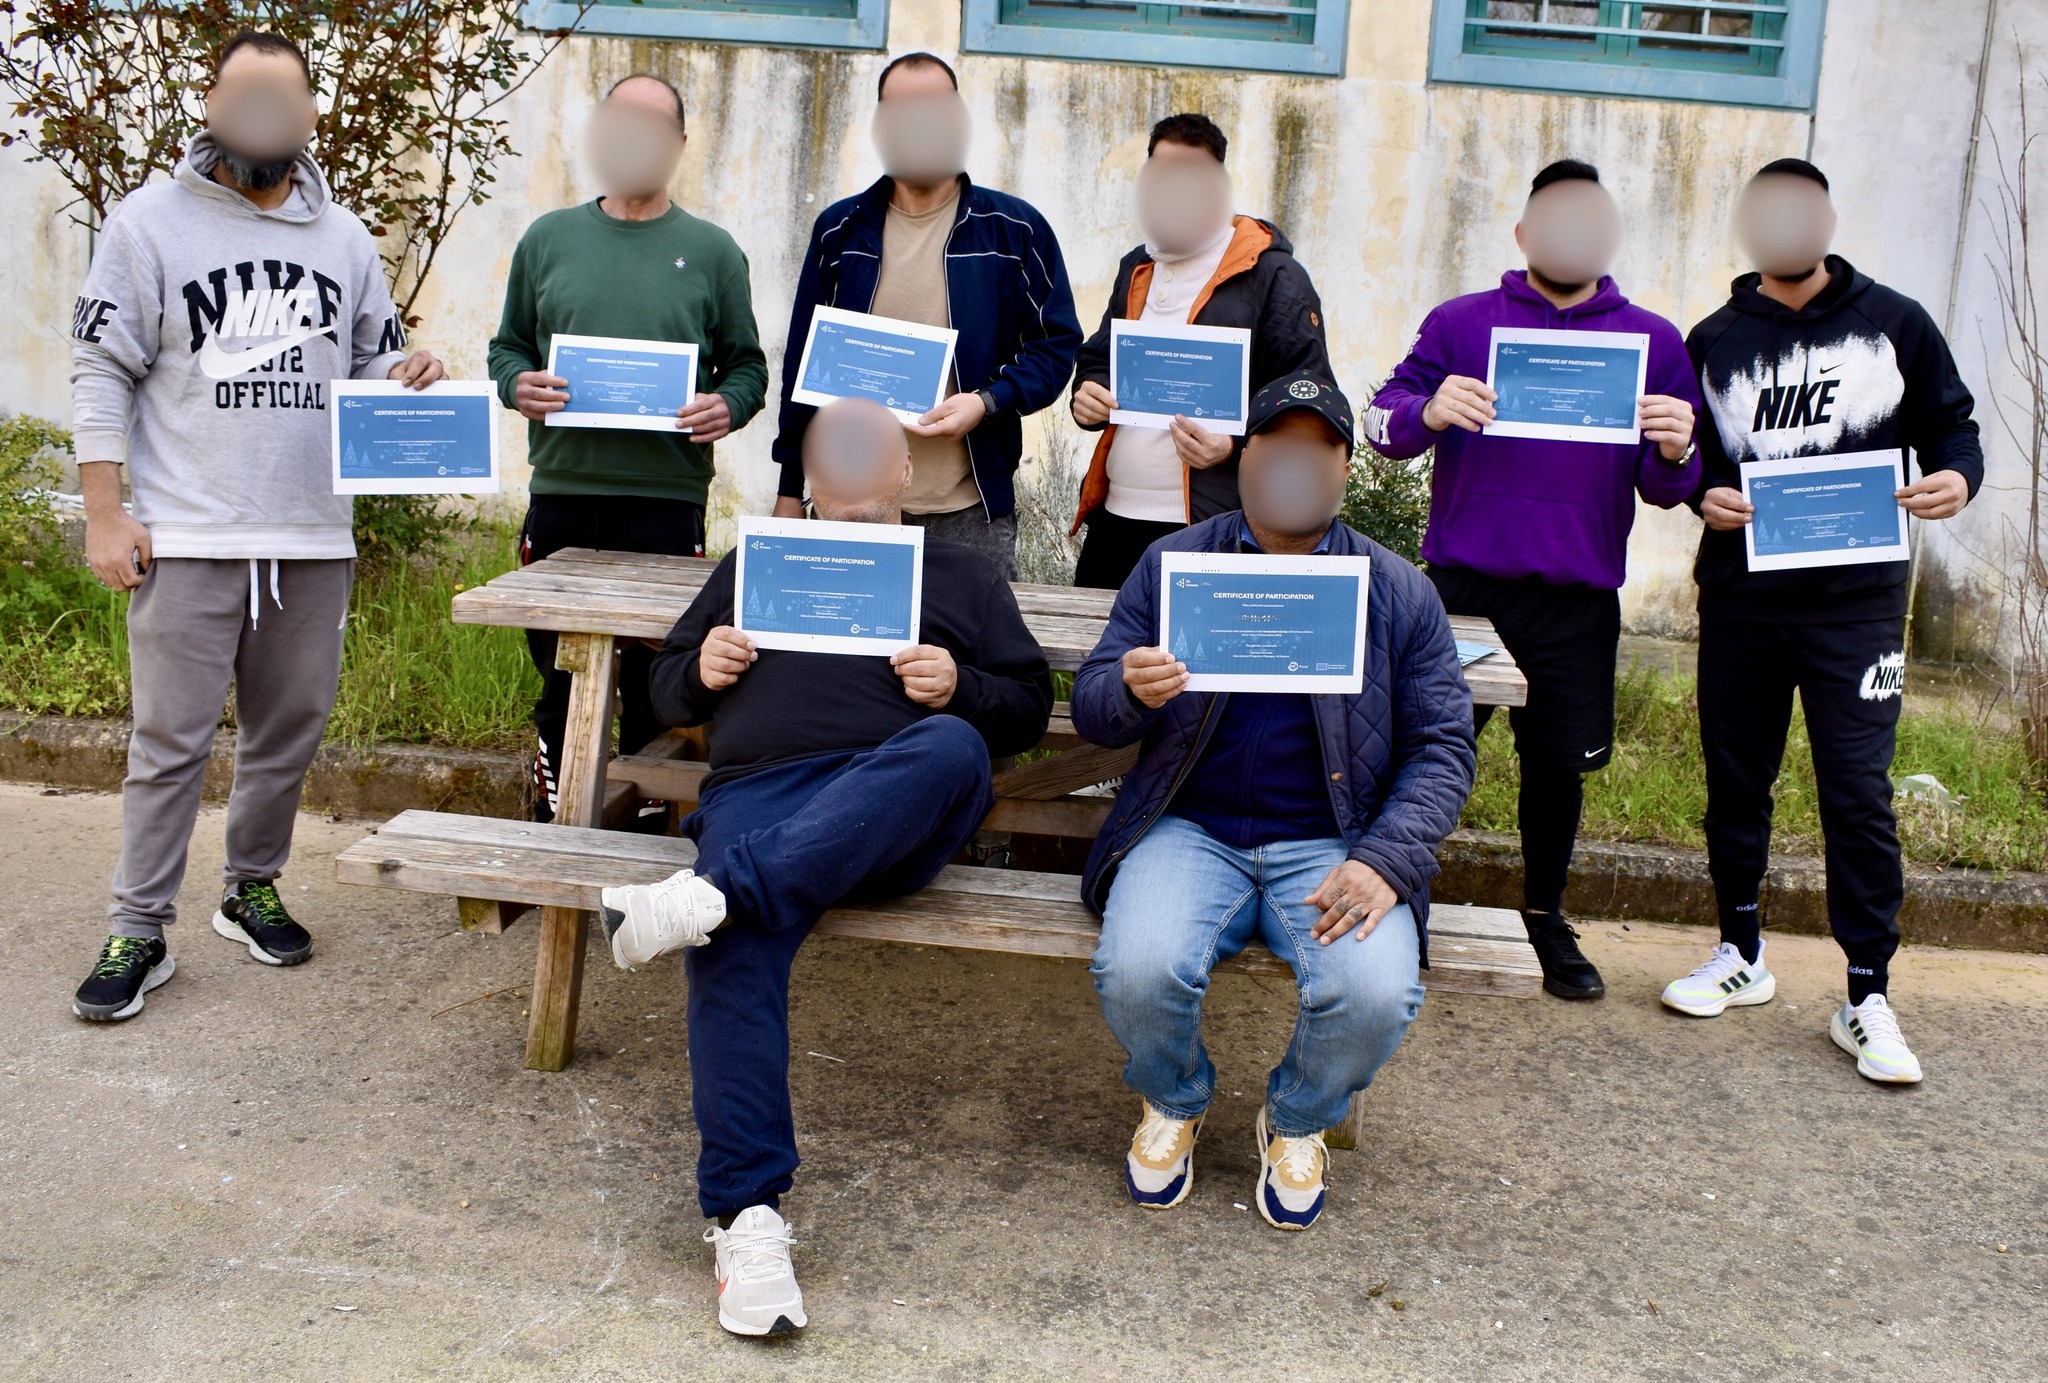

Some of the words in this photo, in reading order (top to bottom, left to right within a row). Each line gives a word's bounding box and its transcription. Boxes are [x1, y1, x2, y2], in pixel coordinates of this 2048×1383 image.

[72, 295, 119, 344] IKE
[218, 289, 317, 338] NIKE
[844, 338, 874, 348] CERTIFICATE
[881, 344, 915, 356] PARTICIPATION
[586, 357, 616, 365] CERTIFICATE
[1145, 350, 1172, 358] CERTIFICATE
[1180, 353, 1213, 361] PARTICIPATION
[1528, 357, 1560, 365] CERTIFICATE
[215, 381, 325, 410] OFFICIAL
[1752, 379, 1841, 433] NIKE
[1823, 482, 1862, 491] PARTICIPATION
[784, 554, 822, 563] CERTIFICATE
[831, 557, 875, 566] PARTICIPATION
[1213, 592, 1255, 600] CERTIFICATE
